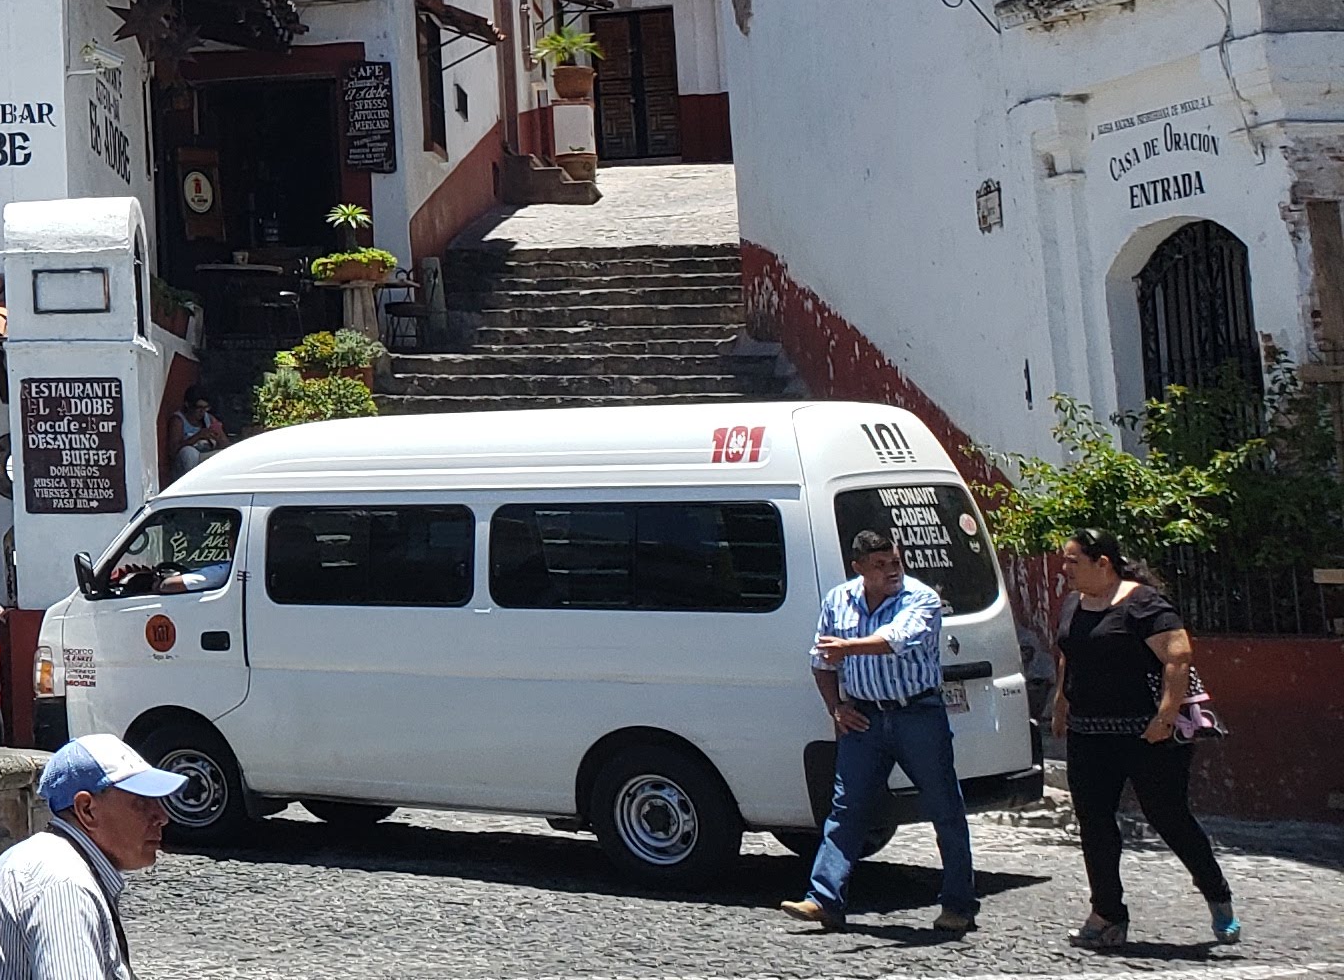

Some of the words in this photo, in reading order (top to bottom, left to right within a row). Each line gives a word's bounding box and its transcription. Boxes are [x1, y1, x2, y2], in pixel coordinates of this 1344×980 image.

[0, 103, 57, 127] BAR
[1143, 137, 1160, 160] DE
[1129, 171, 1206, 209] ENTRADA
[22, 382, 121, 399] RESTAURANTE
[57, 398, 114, 416] ADOBE
[28, 433, 99, 449] DESAYUNO
[711, 425, 767, 464] 101
[860, 422, 917, 464] 101
[61, 449, 117, 466] BUFFET
[49, 466, 100, 477] DOMINGOS
[33, 478, 68, 488] MUSICA
[70, 478, 84, 488] EN
[86, 478, 111, 489] VIVO
[70, 488, 78, 498] Y
[878, 486, 940, 508] INFONAVIT
[891, 506, 942, 527] CADENA
[890, 525, 953, 547] PLAZUELA
[904, 547, 954, 569] C.B.T.I.S.
